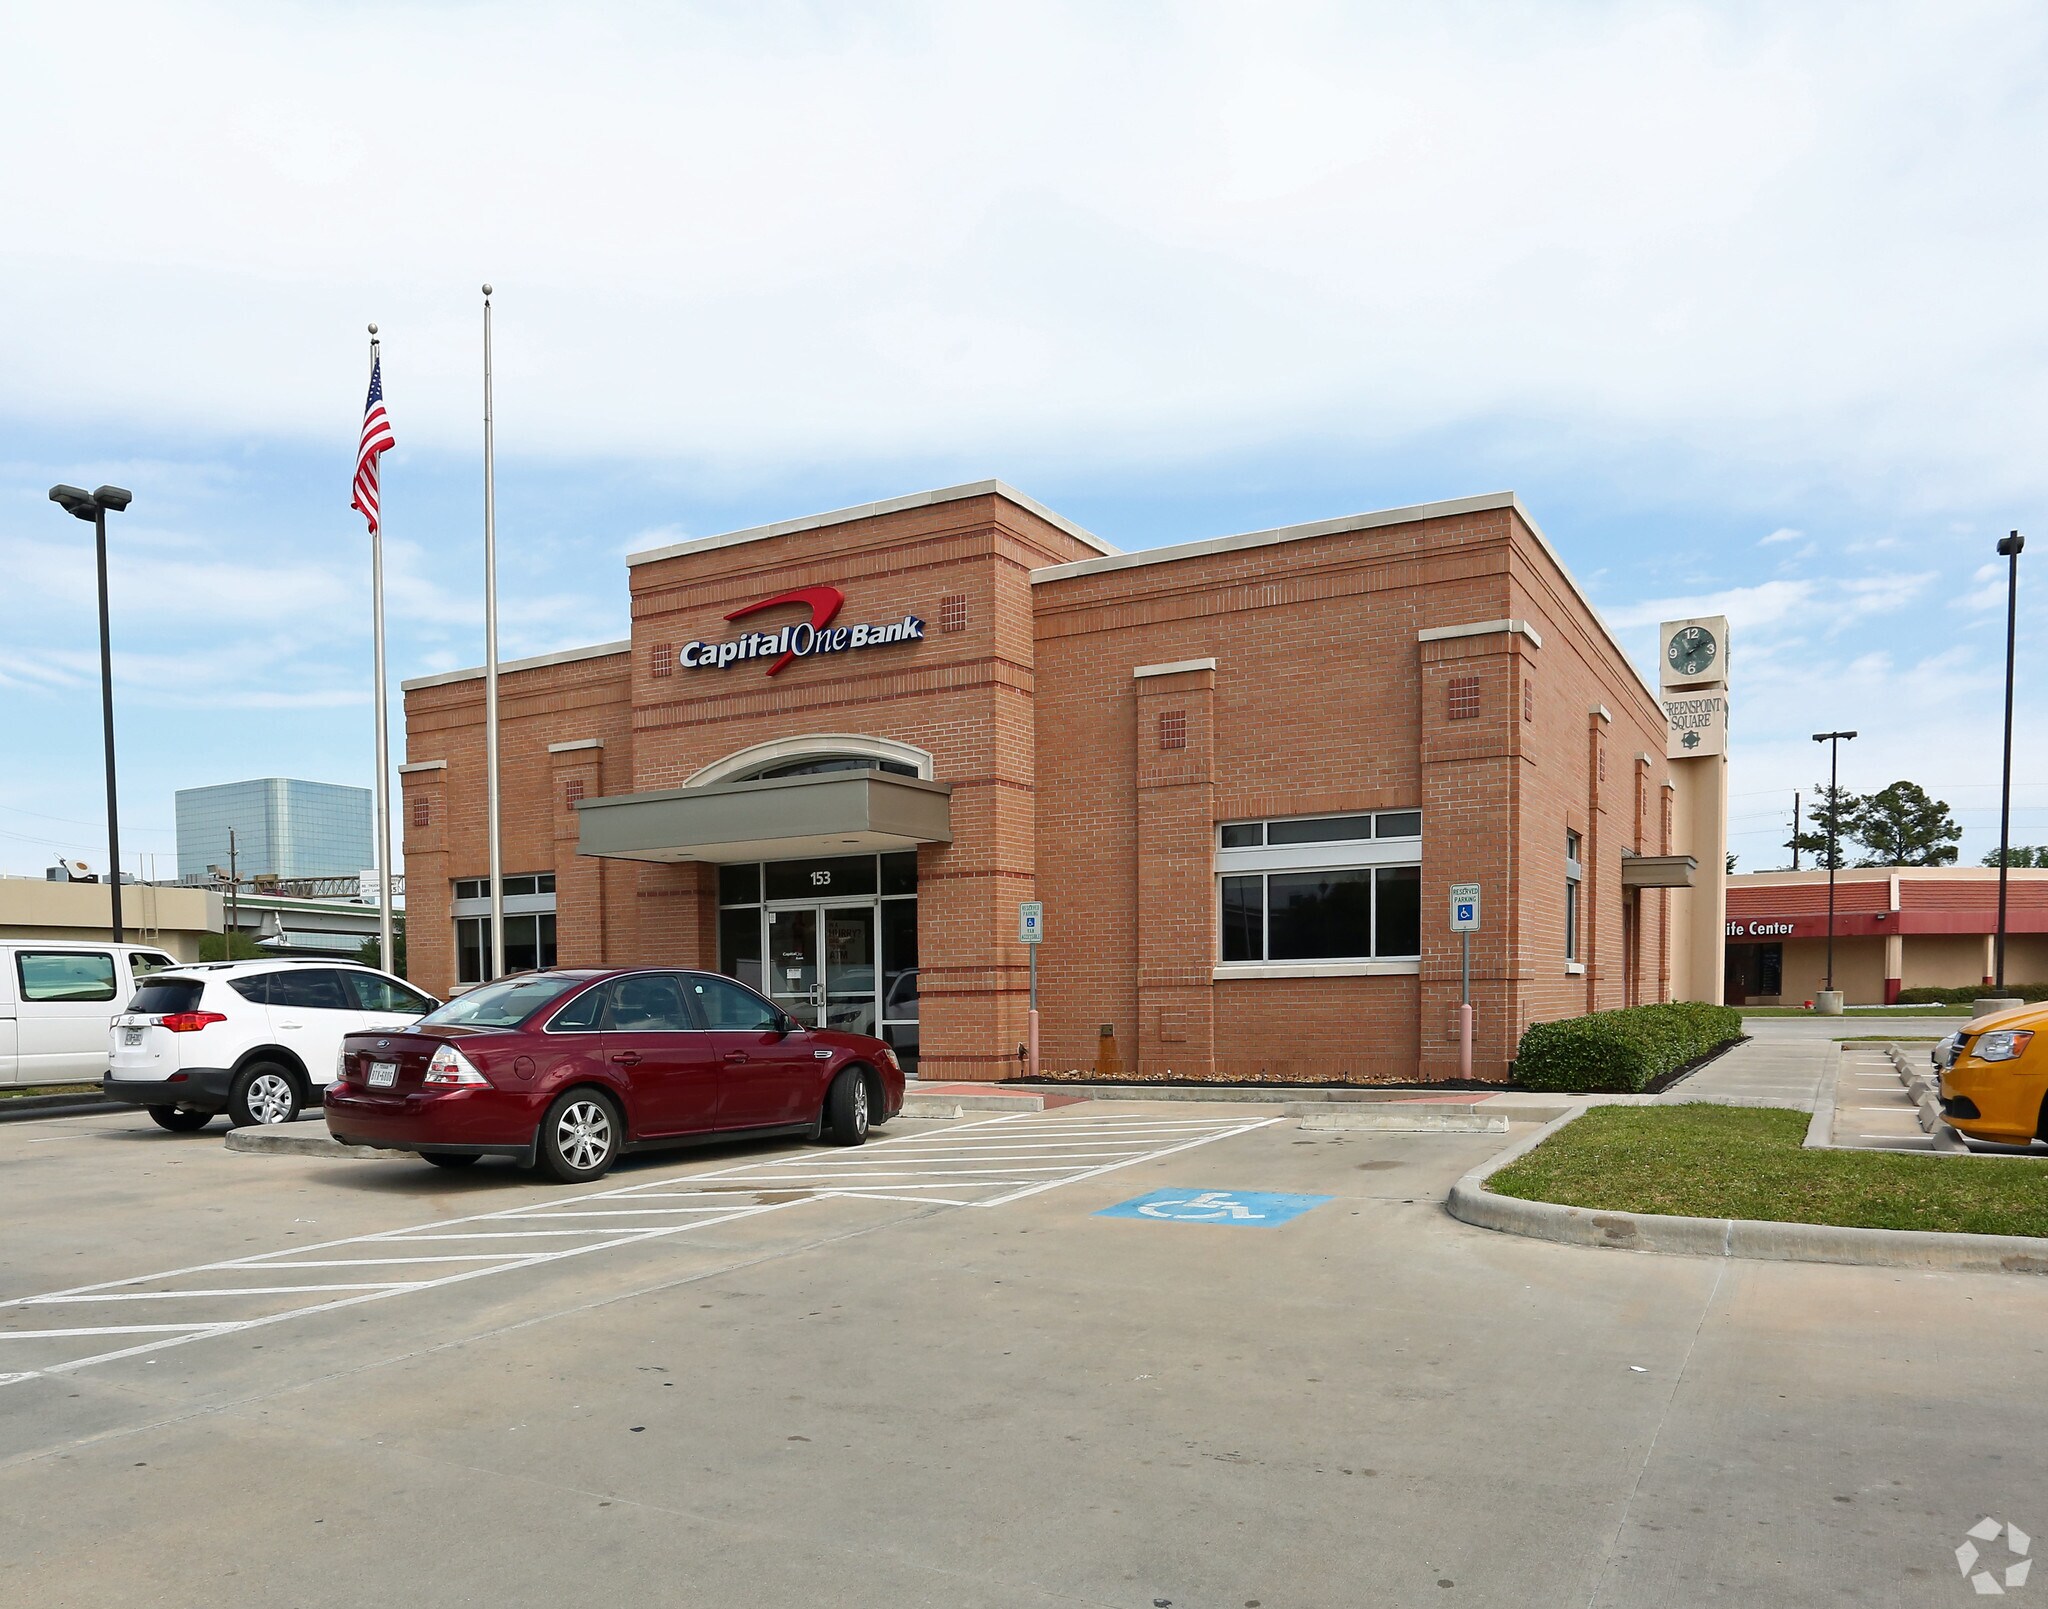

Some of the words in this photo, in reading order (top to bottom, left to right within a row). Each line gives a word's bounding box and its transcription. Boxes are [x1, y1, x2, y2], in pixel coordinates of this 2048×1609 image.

[850, 615, 921, 648] Bank
[1685, 628, 1699, 640] 12
[1669, 648, 1678, 659] 9
[1706, 643, 1715, 655] 3
[1687, 663, 1696, 674] 6
[1671, 713, 1711, 731] SQUARE
[810, 870, 831, 886] 153
[1726, 921, 1744, 936] ife
[1749, 921, 1794, 935] Center
[829, 950, 848, 960] ATM
